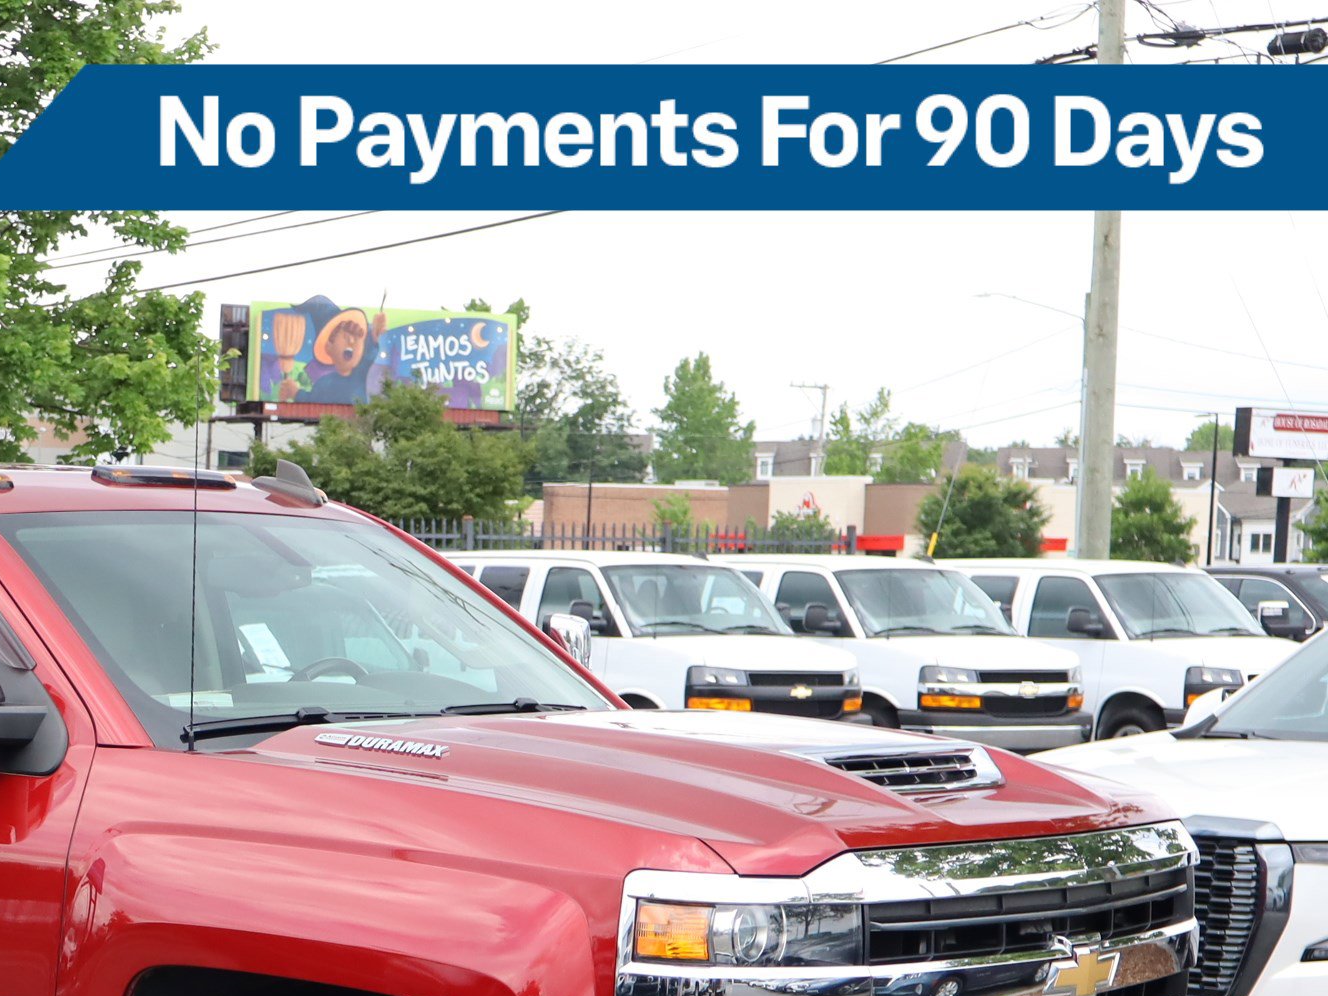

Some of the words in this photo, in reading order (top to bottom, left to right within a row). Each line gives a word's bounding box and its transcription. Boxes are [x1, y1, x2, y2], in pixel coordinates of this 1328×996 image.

[400, 334, 472, 360] LEAMOS
[411, 360, 490, 390] JUNTOS
[347, 735, 450, 759] DURAMAX
